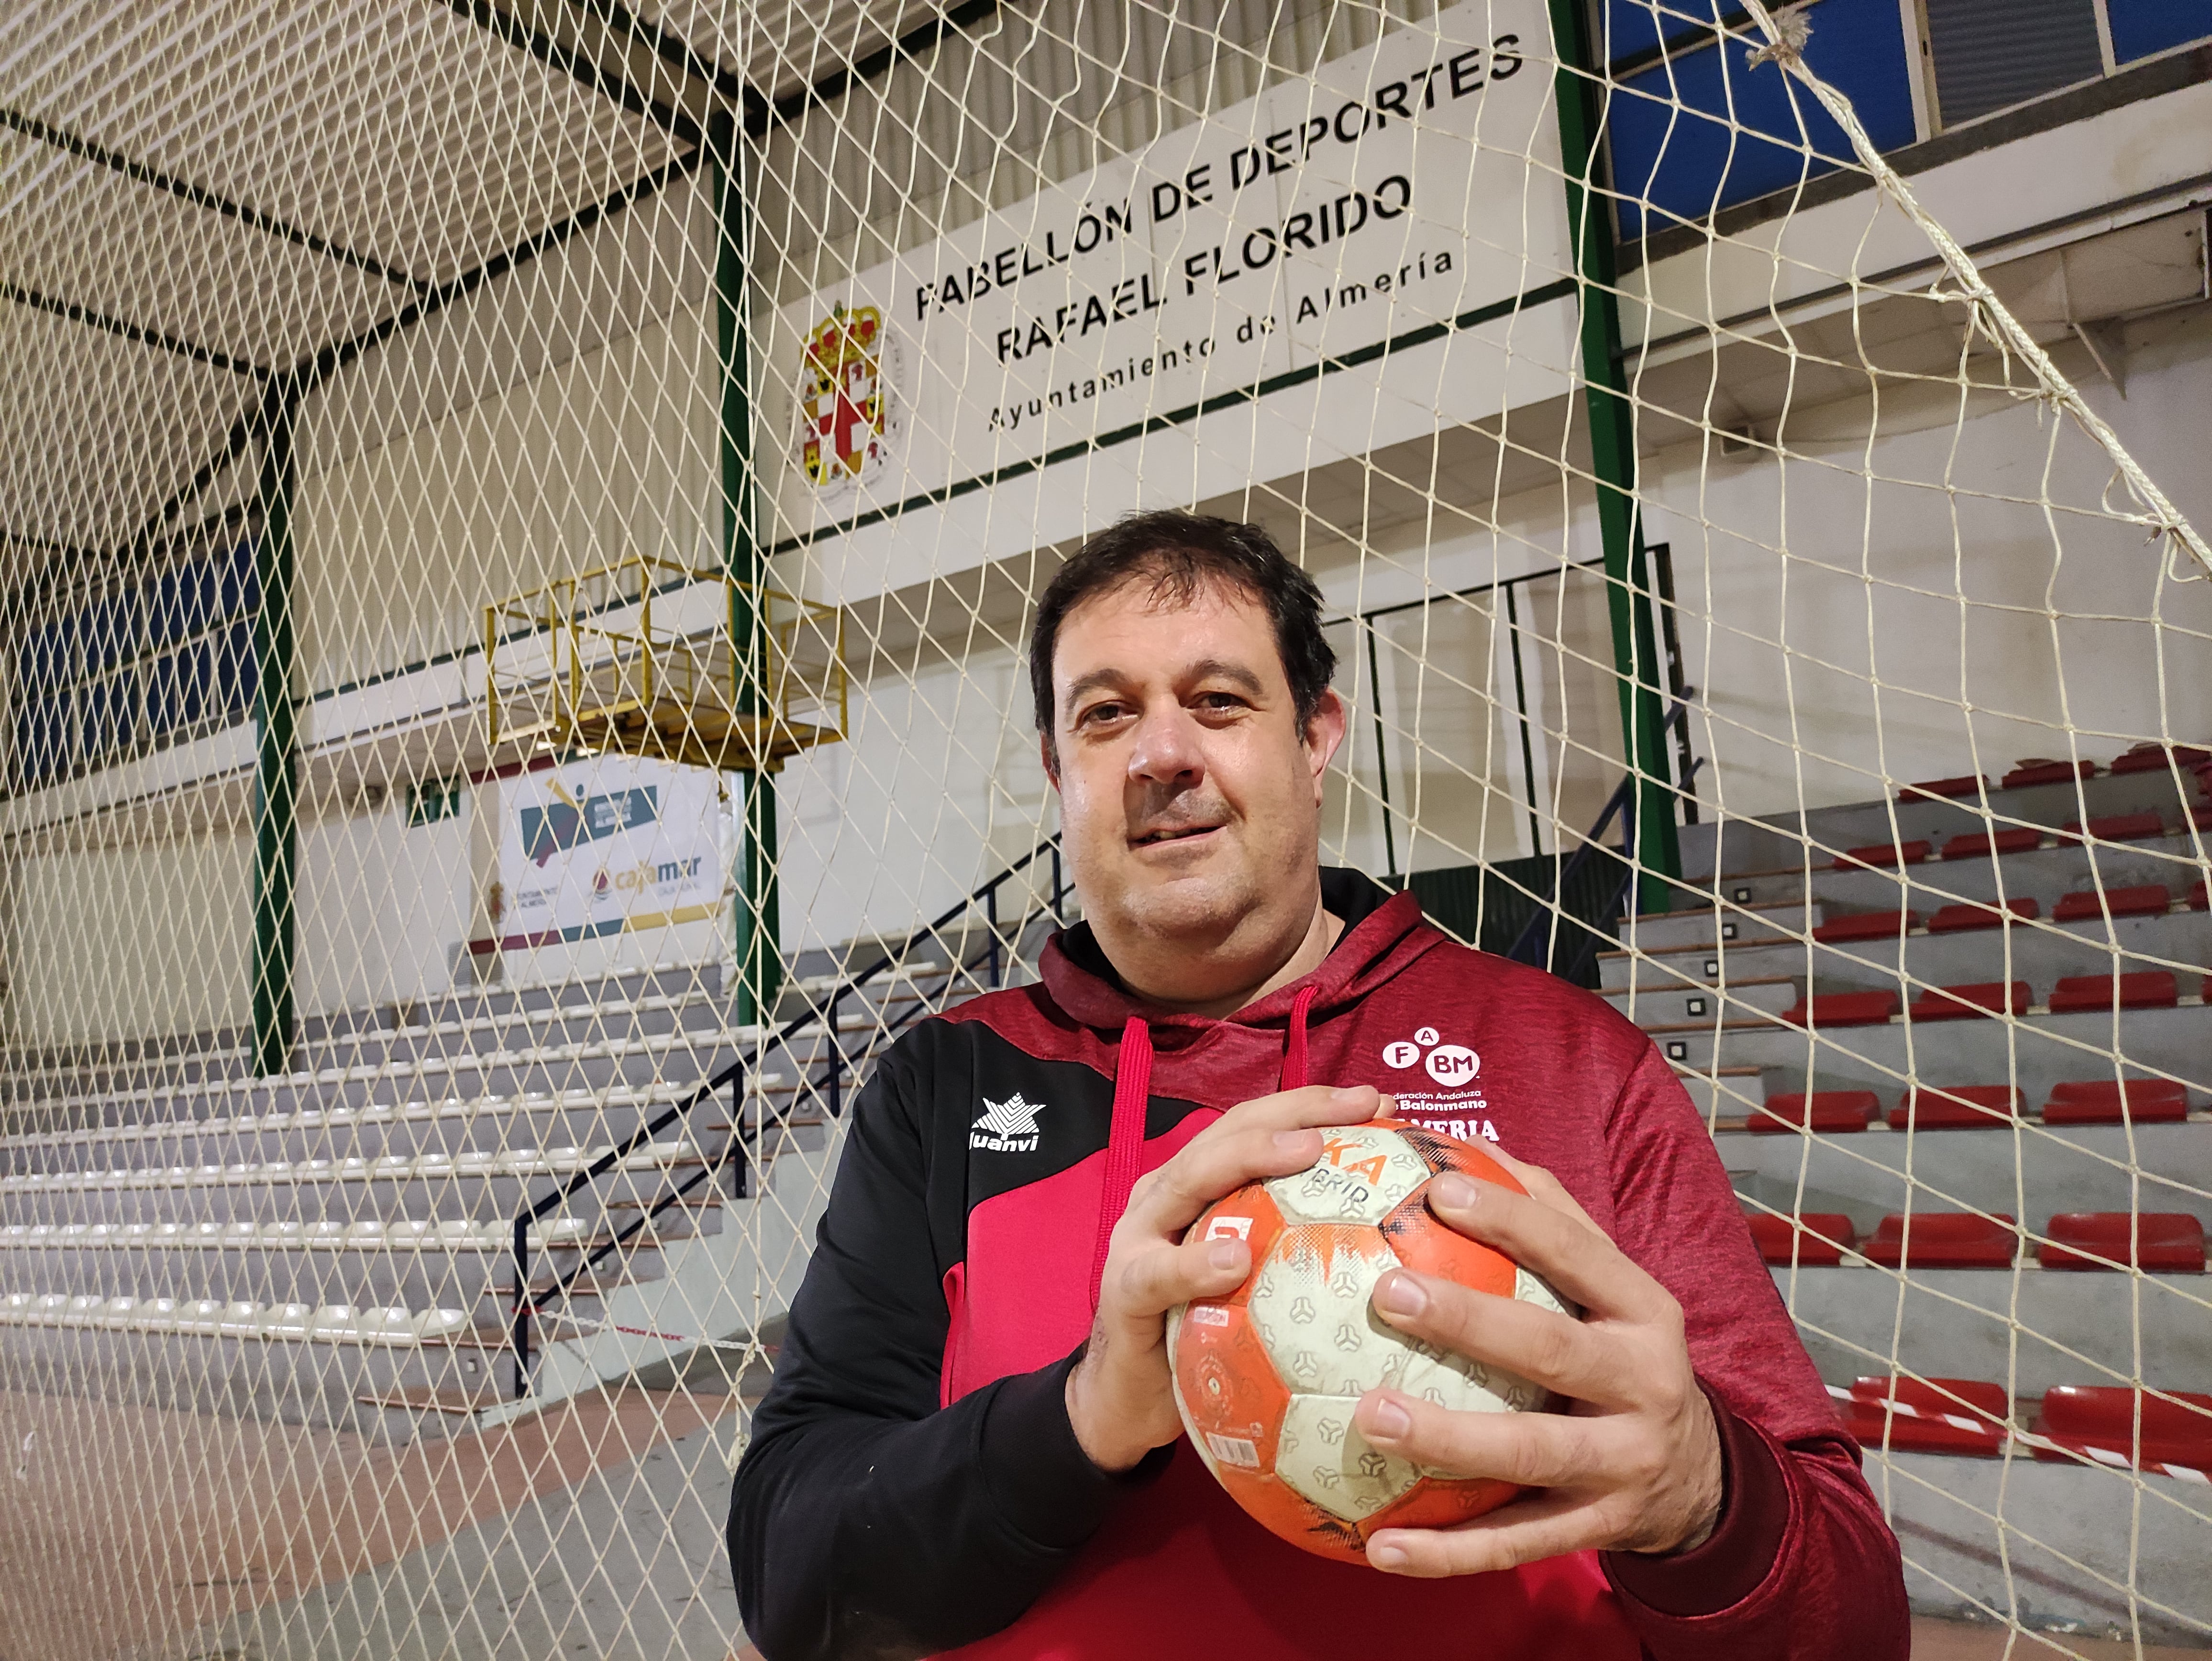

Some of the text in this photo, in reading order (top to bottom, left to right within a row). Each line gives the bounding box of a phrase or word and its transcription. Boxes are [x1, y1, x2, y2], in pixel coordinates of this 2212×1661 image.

[916, 34, 1523, 321] PABELLÓN DE DEPORTES
[997, 175, 1411, 367] RAFAEL FLORIDO
[989, 337, 1216, 432] Ayuntamiento
[1296, 252, 1452, 324] Almería
[615, 856, 702, 896] cajamar
[1420, 1030, 1434, 1042] A
[1394, 1046, 1474, 1074] F BM
[1393, 1089, 1482, 1100] deración Andaluza
[1400, 1100, 1487, 1111] Balonmano
[1311, 1168, 1369, 1202] BRID
